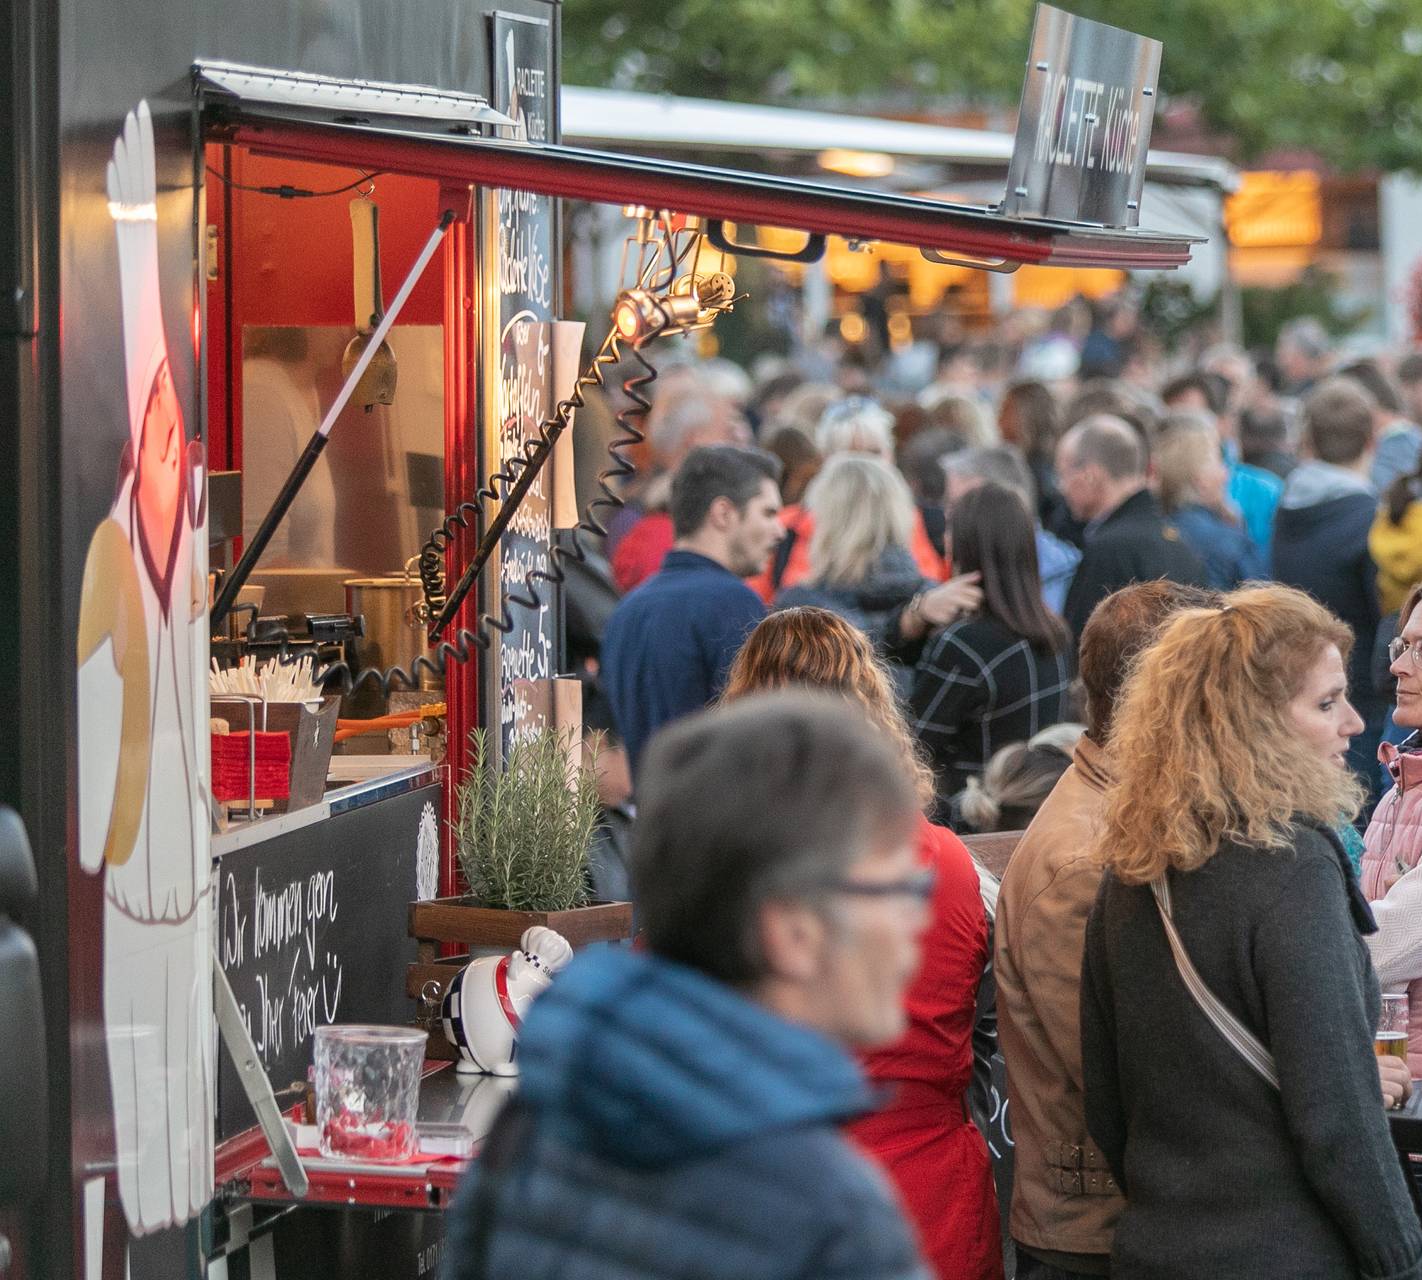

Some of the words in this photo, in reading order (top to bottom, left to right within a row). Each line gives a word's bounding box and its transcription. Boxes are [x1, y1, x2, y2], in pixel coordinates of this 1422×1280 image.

[1101, 87, 1139, 175] Küche
[223, 872, 247, 971] Wir
[254, 866, 303, 959] kommen
